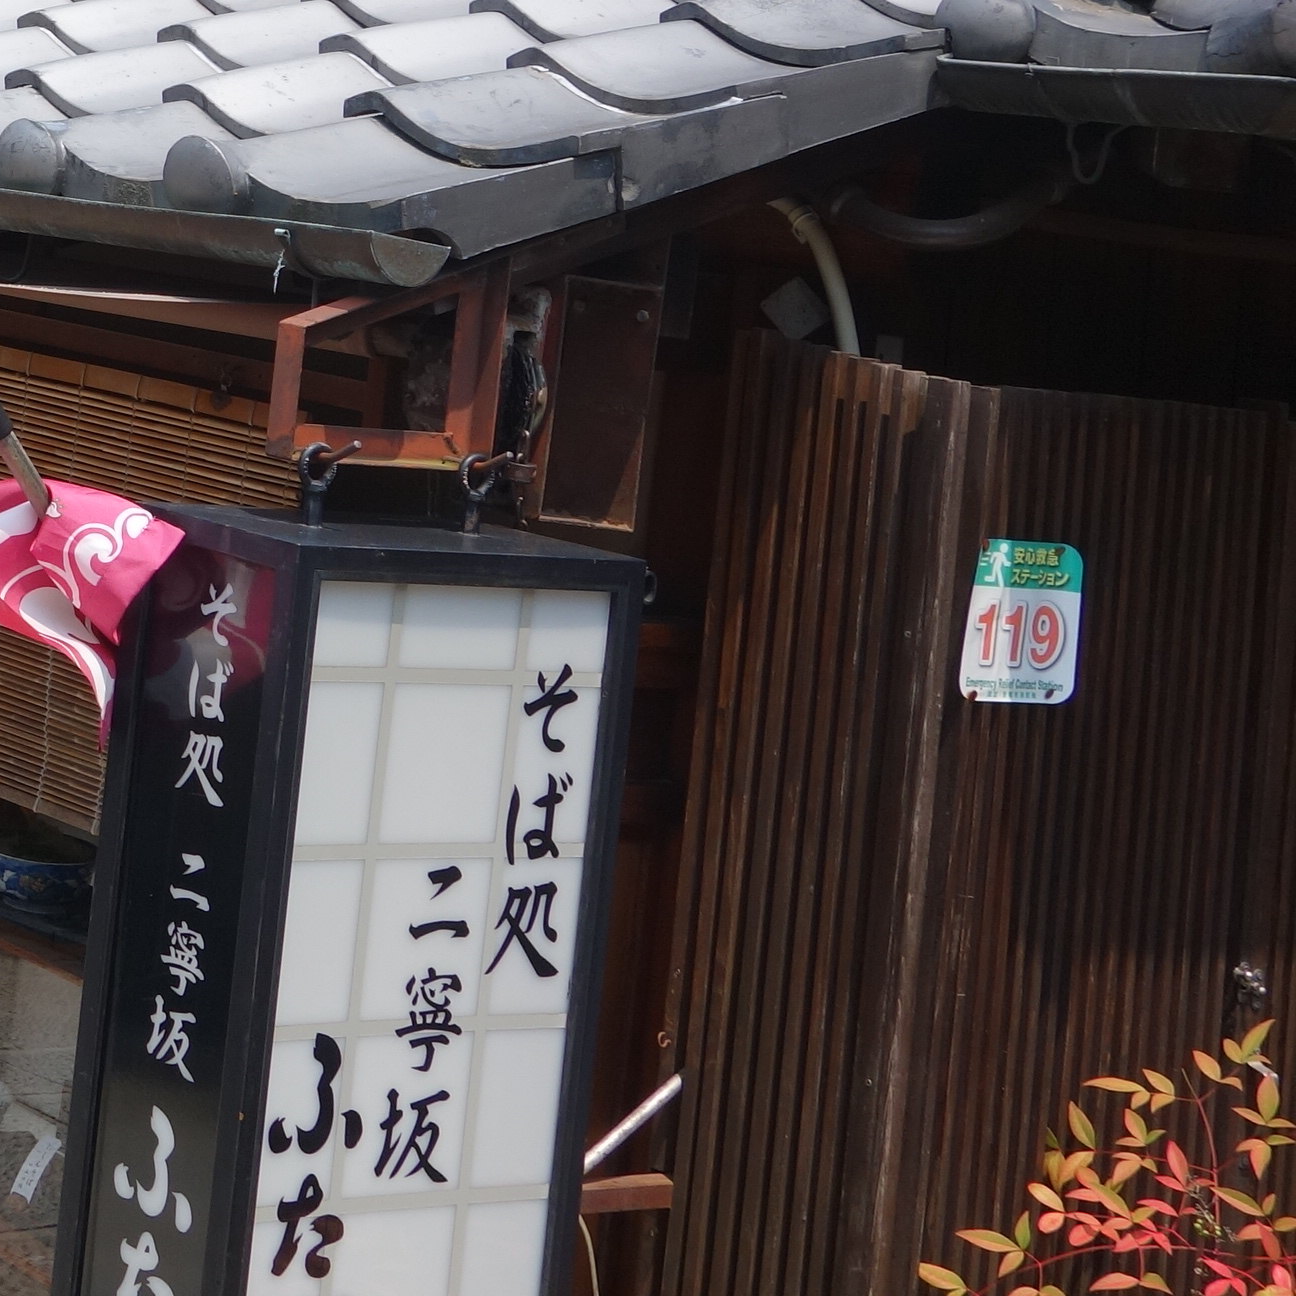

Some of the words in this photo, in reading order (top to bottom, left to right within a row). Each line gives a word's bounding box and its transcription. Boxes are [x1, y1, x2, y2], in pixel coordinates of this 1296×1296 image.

[976, 601, 1062, 666] 119
[1010, 568, 1069, 586] ステーション
[174, 582, 237, 808] そば処
[484, 663, 579, 979] そば処
[146, 852, 210, 1084] 二寧坂
[373, 865, 469, 1185] 二寧坂
[269, 1032, 362, 1279] ふた
